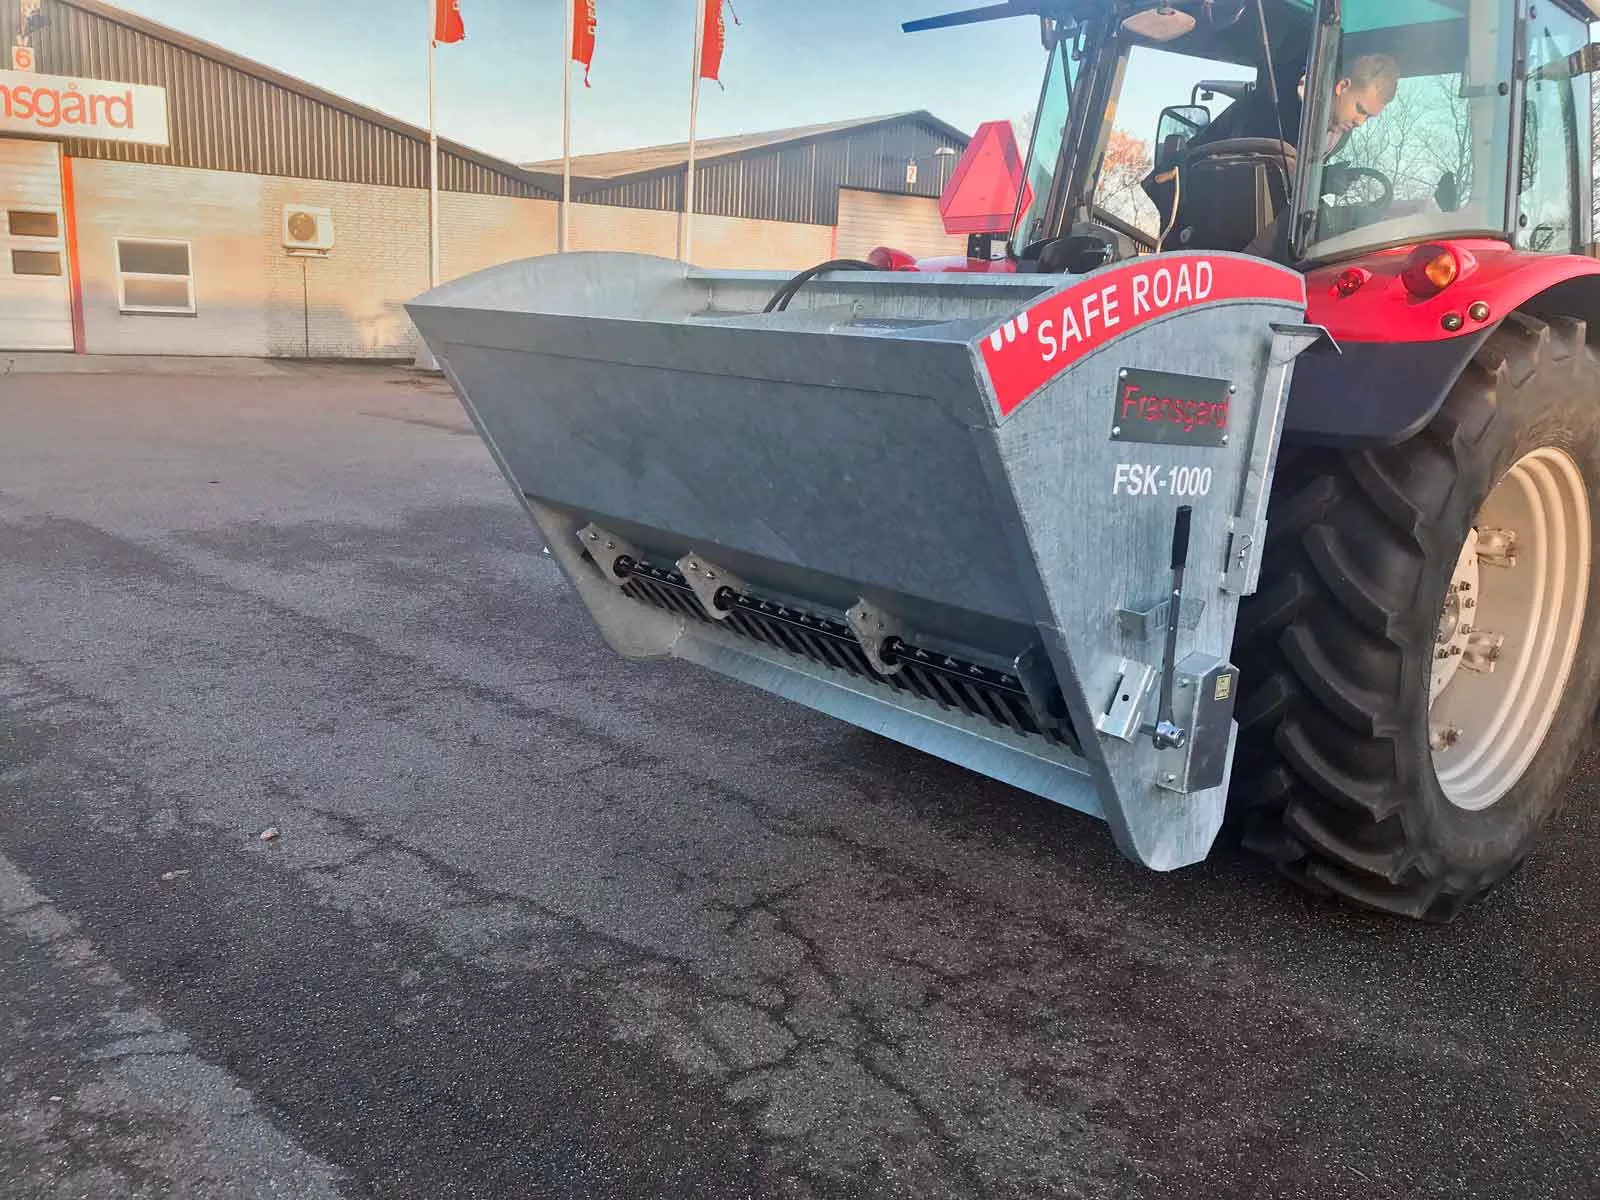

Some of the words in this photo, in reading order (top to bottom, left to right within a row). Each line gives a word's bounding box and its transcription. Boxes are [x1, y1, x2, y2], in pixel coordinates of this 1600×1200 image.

[15, 49, 31, 68] 6
[1037, 284, 1121, 361] SAFE
[1132, 261, 1213, 317] ROAD
[1112, 463, 1213, 496] FSK-1000
